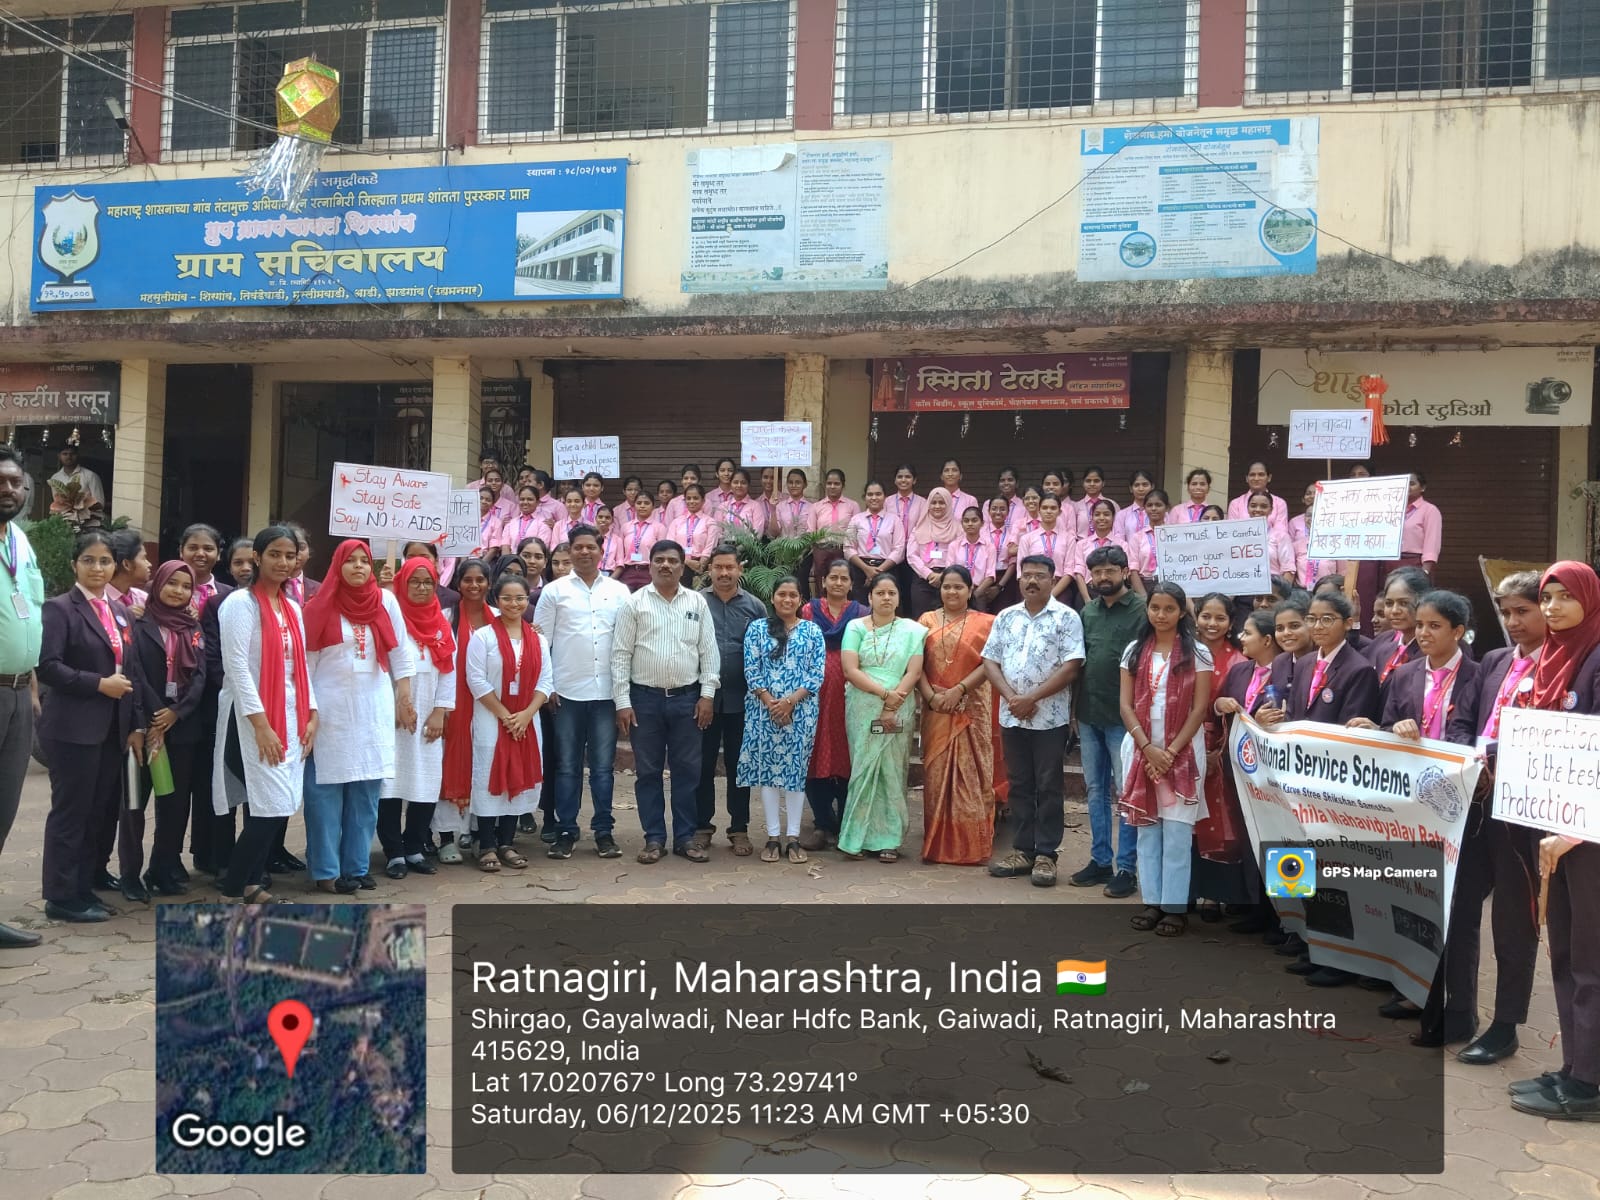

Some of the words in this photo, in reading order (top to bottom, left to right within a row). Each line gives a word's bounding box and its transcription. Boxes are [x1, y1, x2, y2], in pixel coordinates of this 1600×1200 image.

[527, 169, 556, 177] स्थापना
[107, 205, 142, 219] महाराष्ट्र
[145, 204, 190, 216] शासनाच्या
[214, 199, 249, 216] तंटामुक्त
[311, 192, 354, 209] रत्नागिरी
[400, 192, 425, 204] प्रथम
[428, 189, 461, 204] शांतता
[463, 190, 507, 206] पुरस्कार
[508, 188, 531, 201] प्राप्त
[174, 252, 244, 279] ग्राम
[255, 240, 448, 280] सचिवालय
[917, 365, 992, 392] स्मिता
[1000, 361, 1065, 391] टेलर्स
[12, 384, 60, 408] कटींग
[65, 391, 111, 416] सलून
[1424, 399, 1492, 422] स्टुडिओ
[354, 468, 388, 490] Stay
[391, 472, 429, 489] Aware
[352, 489, 386, 511] Stay
[391, 492, 422, 510] Safe
[334, 507, 360, 532] Say
[366, 512, 388, 528] NO
[391, 514, 404, 529] to
[408, 514, 443, 532] AIDS
[1160, 528, 1178, 542] One
[1184, 529, 1208, 541] must
[1216, 526, 1228, 540] be
[1164, 549, 1174, 563] to
[1203, 552, 1225, 566] your
[1230, 543, 1264, 559] EYES
[1163, 569, 1188, 583] before
[1189, 566, 1220, 581] AIDS
[1223, 567, 1250, 580] closes
[1254, 564, 1262, 578] it
[1296, 744, 1349, 785] Service
[1353, 754, 1412, 799] Scheme
[1527, 751, 1539, 780] is
[1302, 787, 1325, 801] Stree
[1323, 791, 1356, 808] Shikshan
[1500, 782, 1587, 829] Protection
[1327, 808, 1415, 849] Mahavidyalay
[1340, 836, 1393, 862] Ratnagiri
